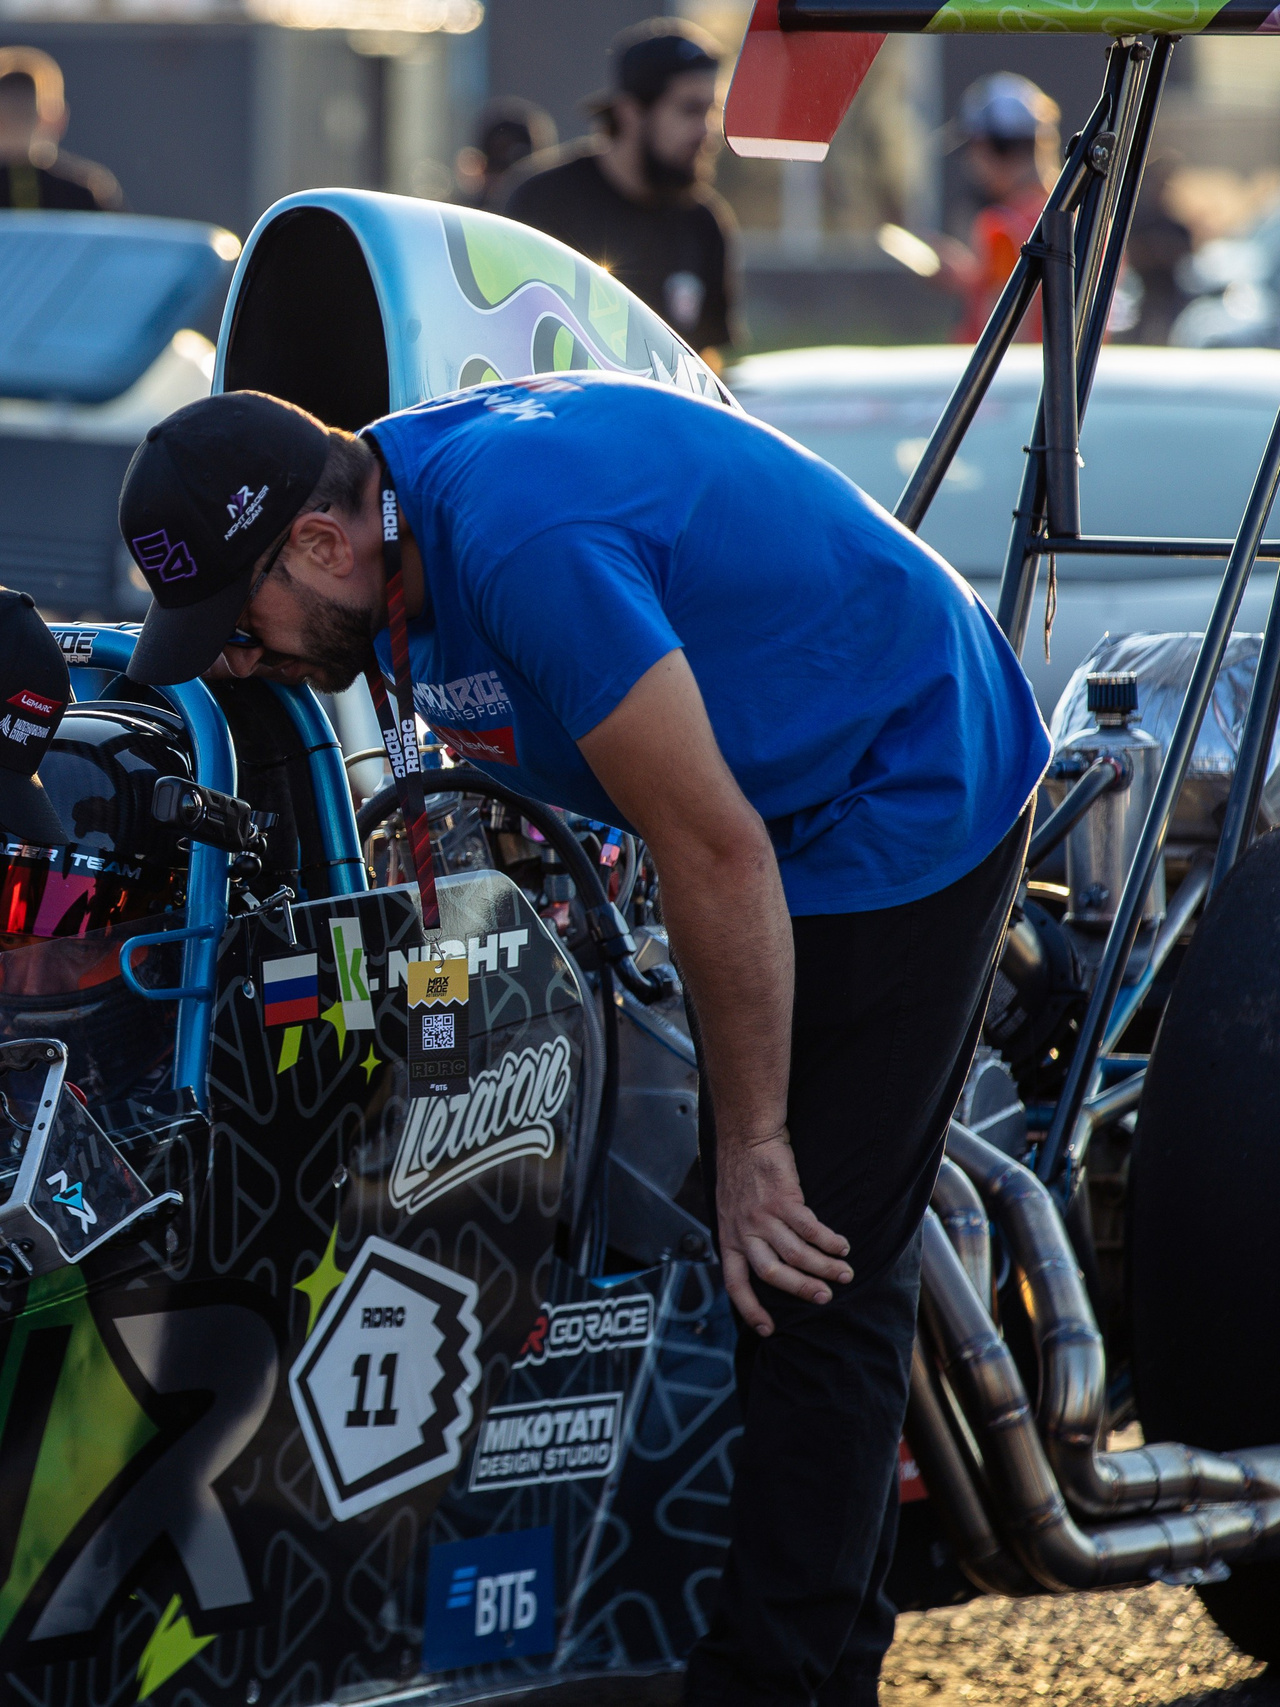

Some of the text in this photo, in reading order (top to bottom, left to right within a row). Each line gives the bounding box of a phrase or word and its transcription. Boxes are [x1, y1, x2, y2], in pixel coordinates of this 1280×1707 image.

[224, 485, 270, 541] NIGHT RACER
[241, 505, 264, 530] TEAM
[382, 489, 398, 542] RDRC
[132, 529, 198, 583] 54
[21, 694, 53, 713] LEMARC
[383, 728, 406, 779] RDRC
[401, 719, 420, 774] RDRC
[70, 853, 142, 880] TEAM
[427, 985, 449, 993] RIDE
[428, 976, 450, 986] MAX
[411, 1059, 466, 1078] RDRC
[361, 1306, 406, 1329] RDRC
[345, 1353, 400, 1428] 11
[483, 1405, 615, 1454] MIKOTATI
[478, 1442, 611, 1479] DESIGN STUDIO
[475, 1568, 538, 1637] ВТБ
